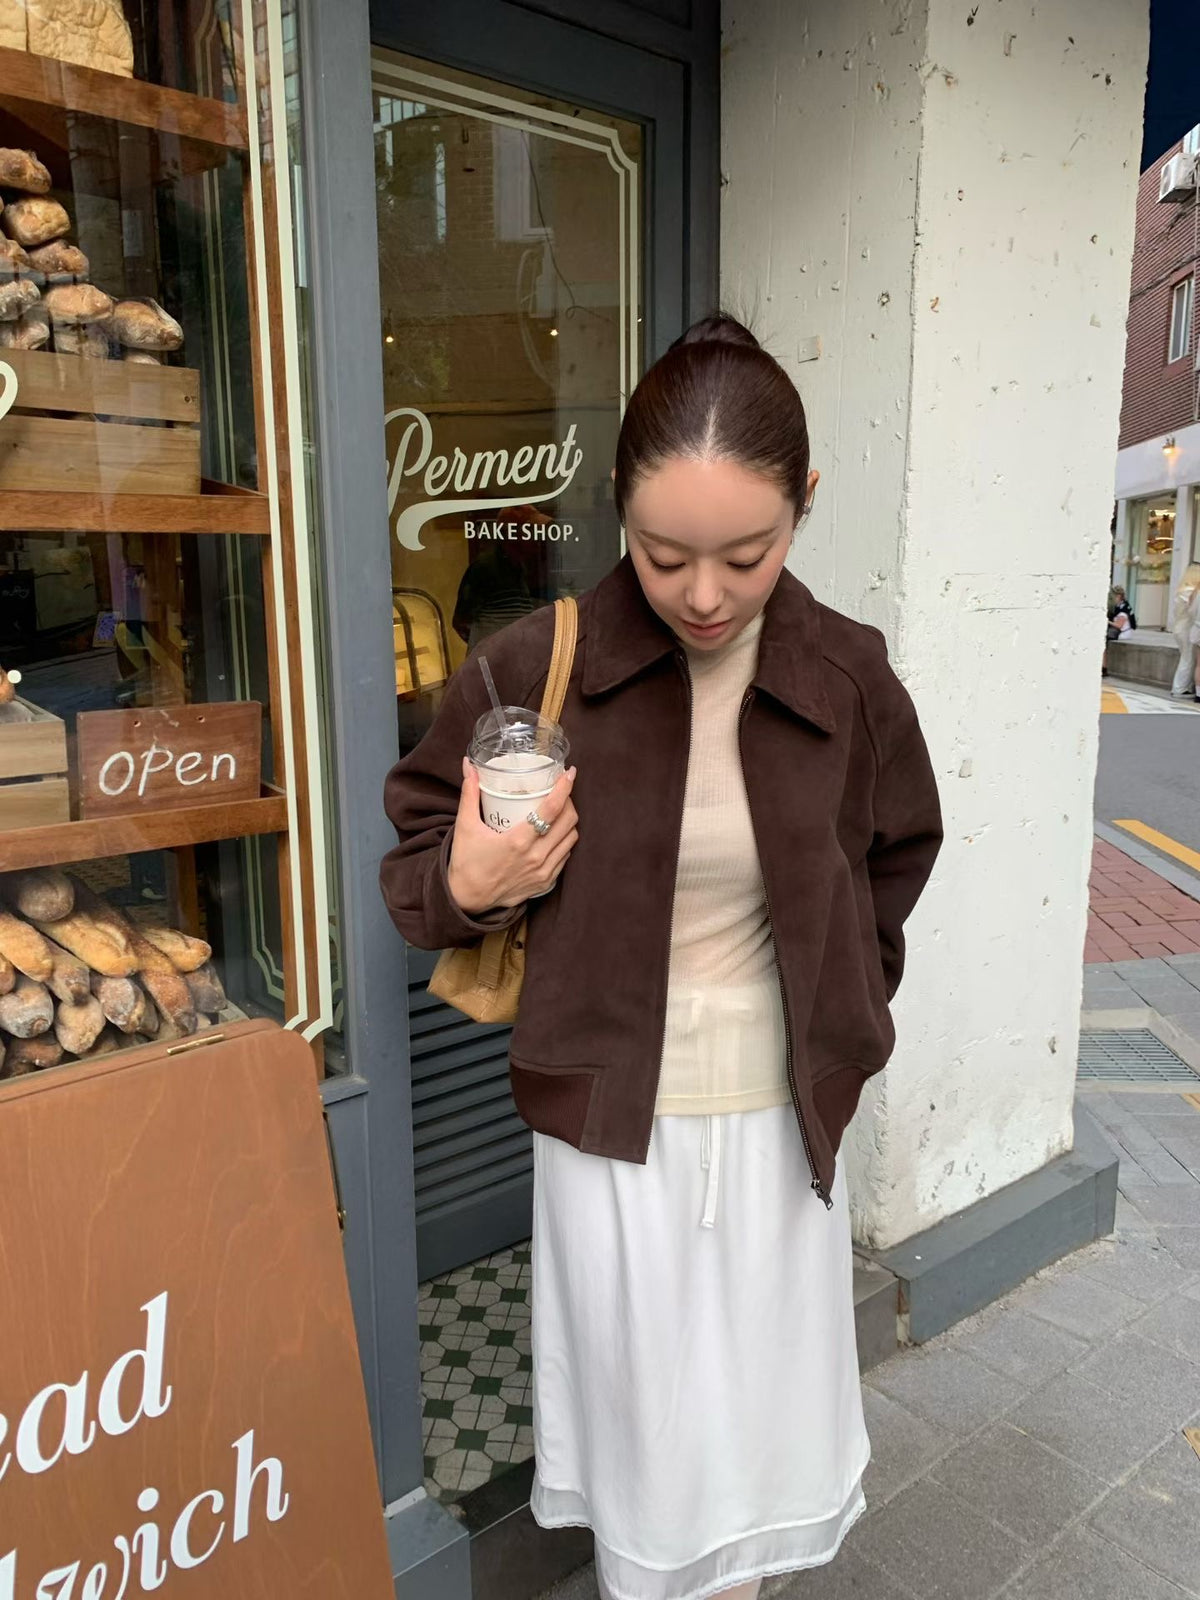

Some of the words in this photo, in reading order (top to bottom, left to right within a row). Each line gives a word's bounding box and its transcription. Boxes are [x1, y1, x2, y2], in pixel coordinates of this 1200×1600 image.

[384, 407, 583, 551] Perment
[463, 520, 580, 542] BAKESHOP.
[0, 1428, 289, 1600] wich
